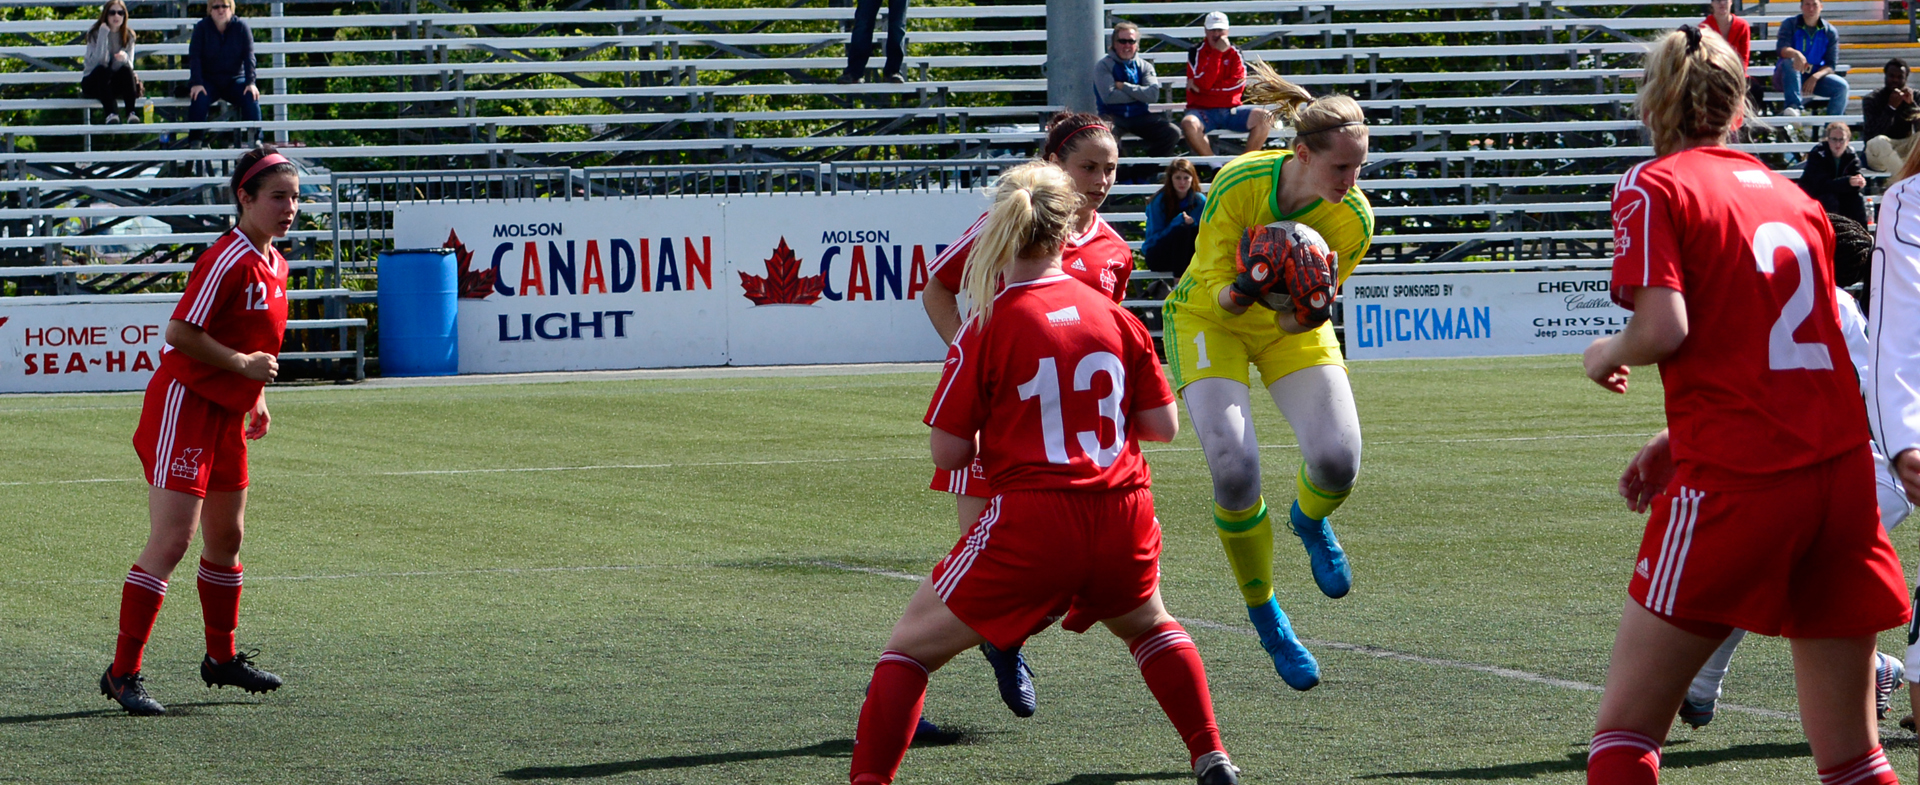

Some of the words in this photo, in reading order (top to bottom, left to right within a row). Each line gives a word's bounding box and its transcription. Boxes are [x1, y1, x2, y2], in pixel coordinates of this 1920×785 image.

[493, 222, 563, 238] MOLSON
[821, 230, 890, 244] MOLSON
[491, 236, 713, 297] CANADIAN
[820, 244, 950, 301] CANA
[244, 281, 269, 310] 12
[1354, 286, 1390, 299] PROUDLY
[1393, 284, 1440, 298] SPONSORED
[1443, 284, 1454, 296] BY
[1564, 294, 1615, 312] Cadillac
[1752, 221, 1834, 371] 2
[25, 326, 107, 347] HOME
[121, 325, 159, 344] OF
[498, 310, 635, 342] LIGHT
[1356, 304, 1491, 348] HICKMAN
[1534, 328, 1558, 339] Jeep
[1193, 331, 1212, 370] 1
[1017, 351, 1126, 467] 13
